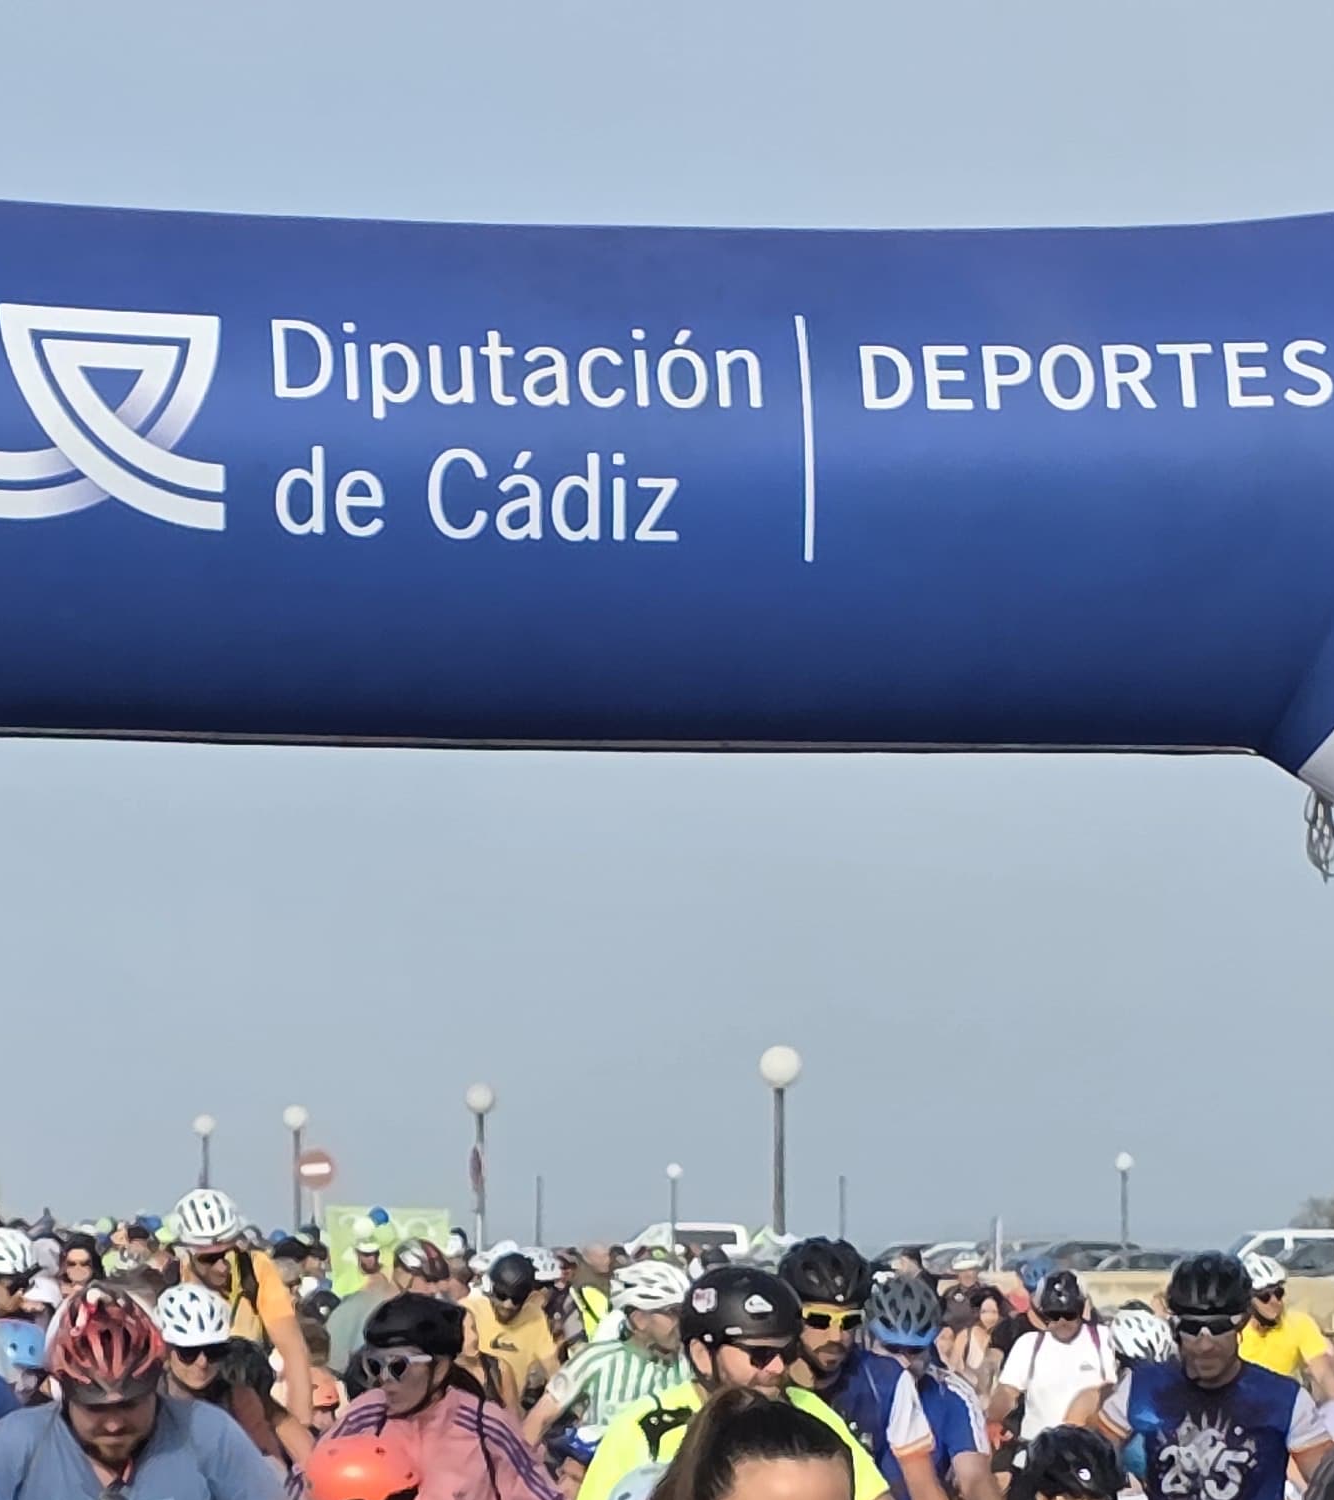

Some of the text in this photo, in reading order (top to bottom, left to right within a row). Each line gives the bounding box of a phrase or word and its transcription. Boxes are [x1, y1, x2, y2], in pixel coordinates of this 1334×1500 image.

[272, 319, 763, 420] Diputación
[860, 339, 1334, 411] DEPORTES
[275, 446, 679, 543] de Cádiz
